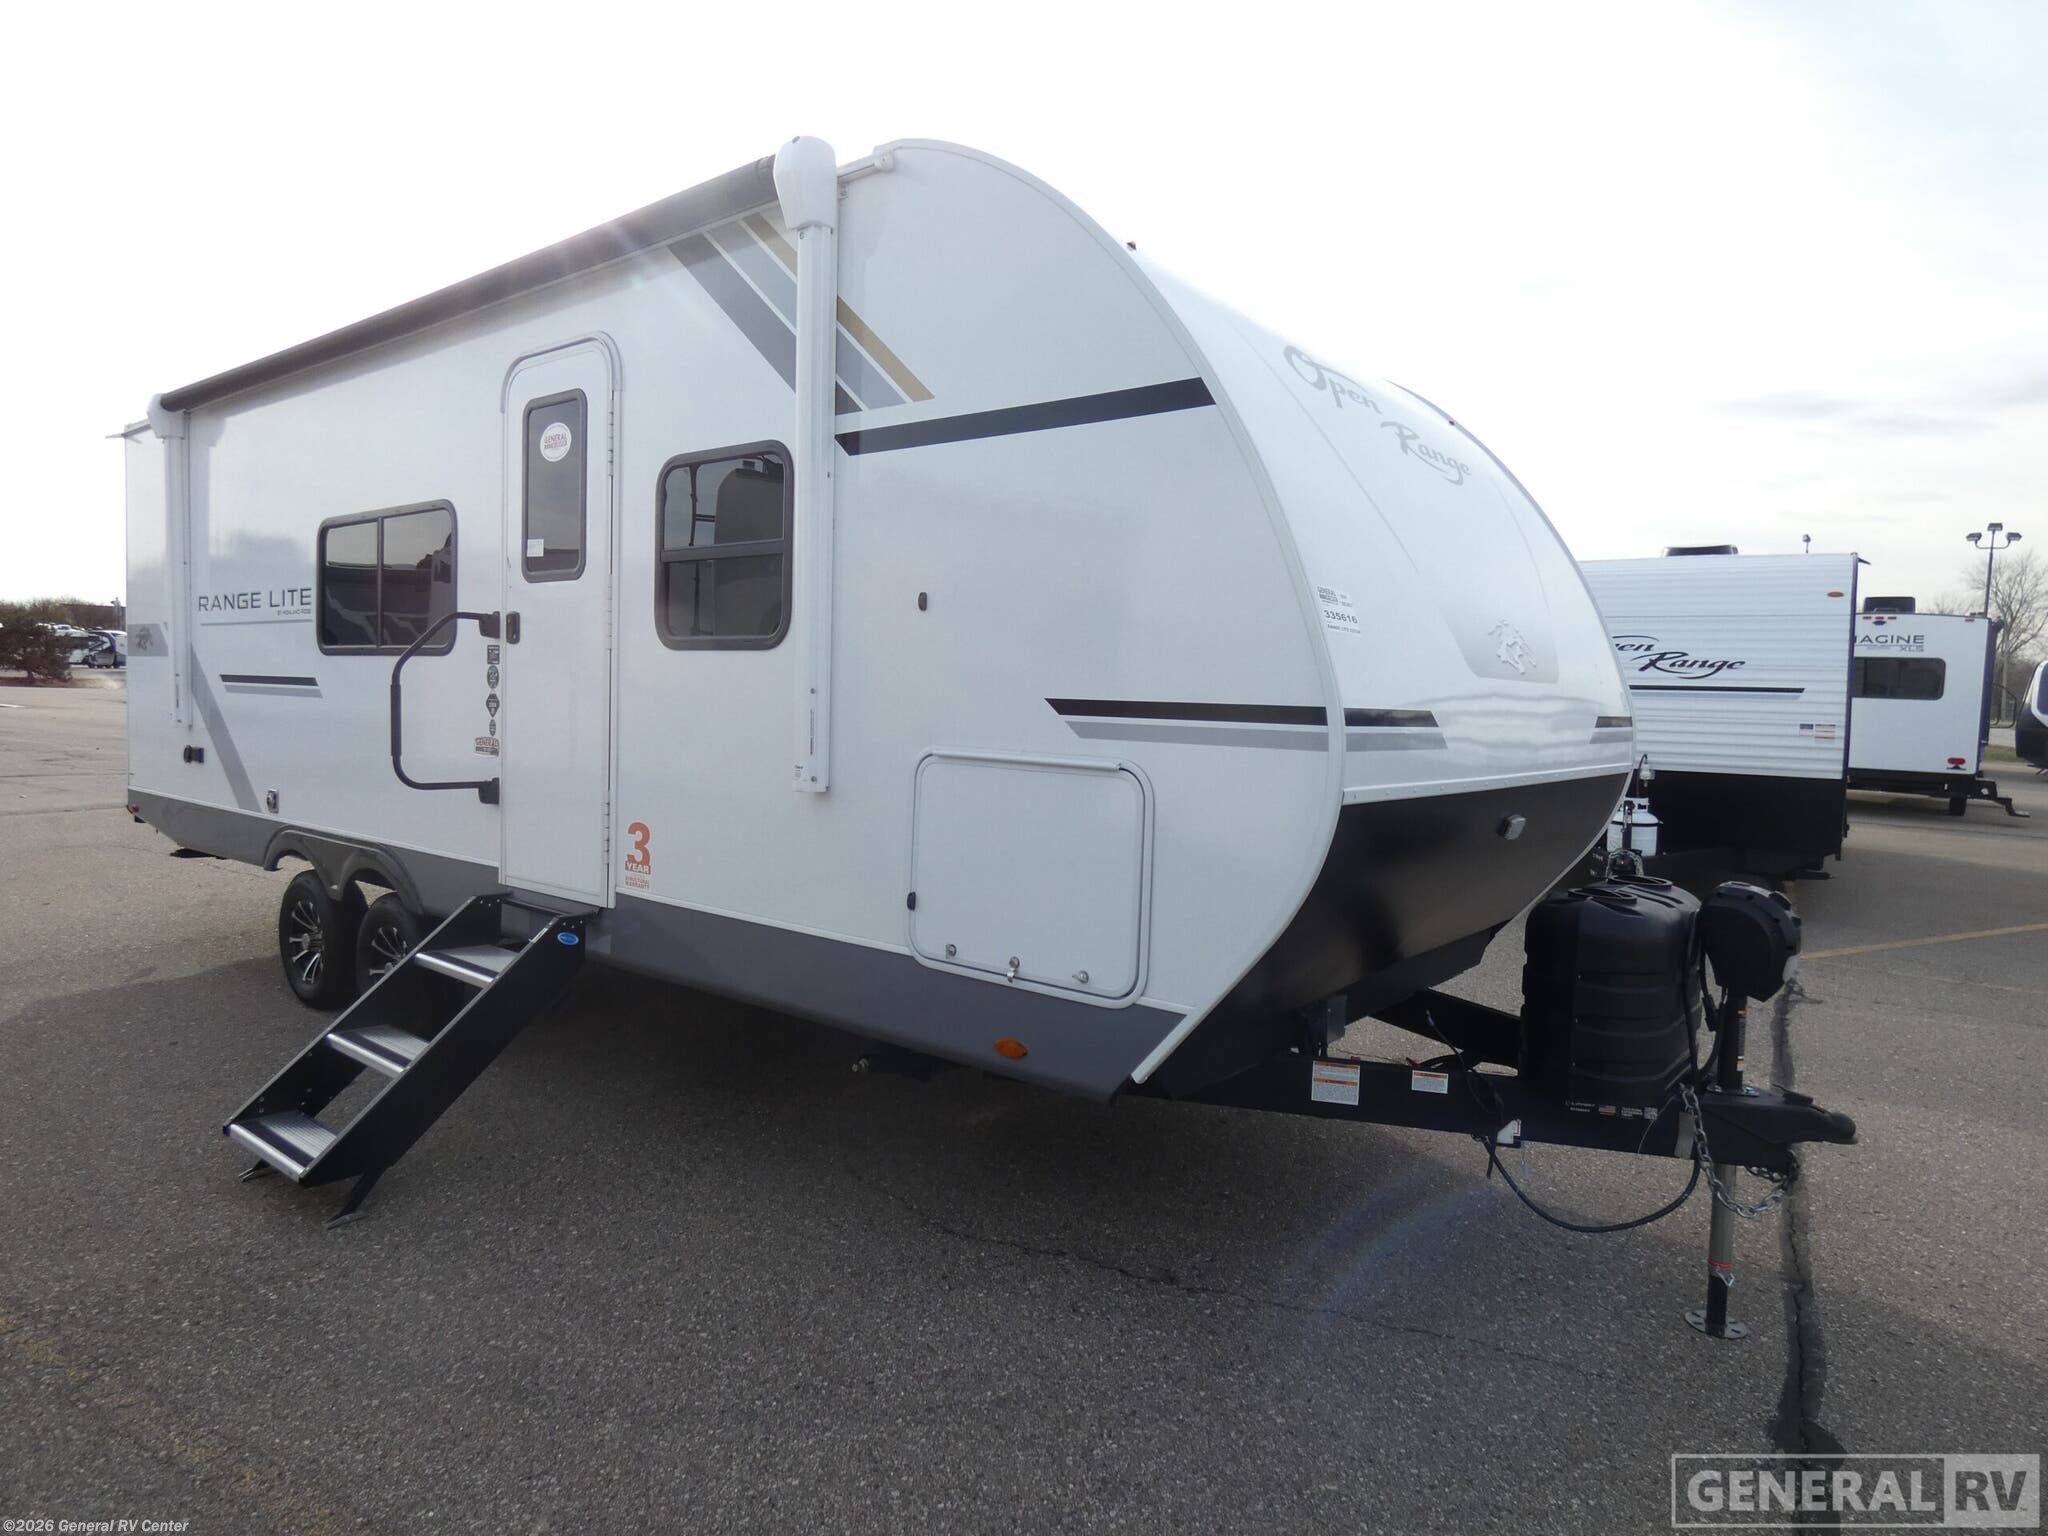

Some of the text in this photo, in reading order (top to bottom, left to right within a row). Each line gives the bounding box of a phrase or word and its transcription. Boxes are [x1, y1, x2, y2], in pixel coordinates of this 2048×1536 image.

[1283, 345, 1382, 415] Open
[1380, 421, 1472, 486] Range
[198, 588, 312, 611] RANGE LITE
[1854, 634, 1925, 644] AGINE
[1630, 651, 1746, 679] Range
[626, 822, 650, 866] 3
[626, 862, 650, 874] YEAR
